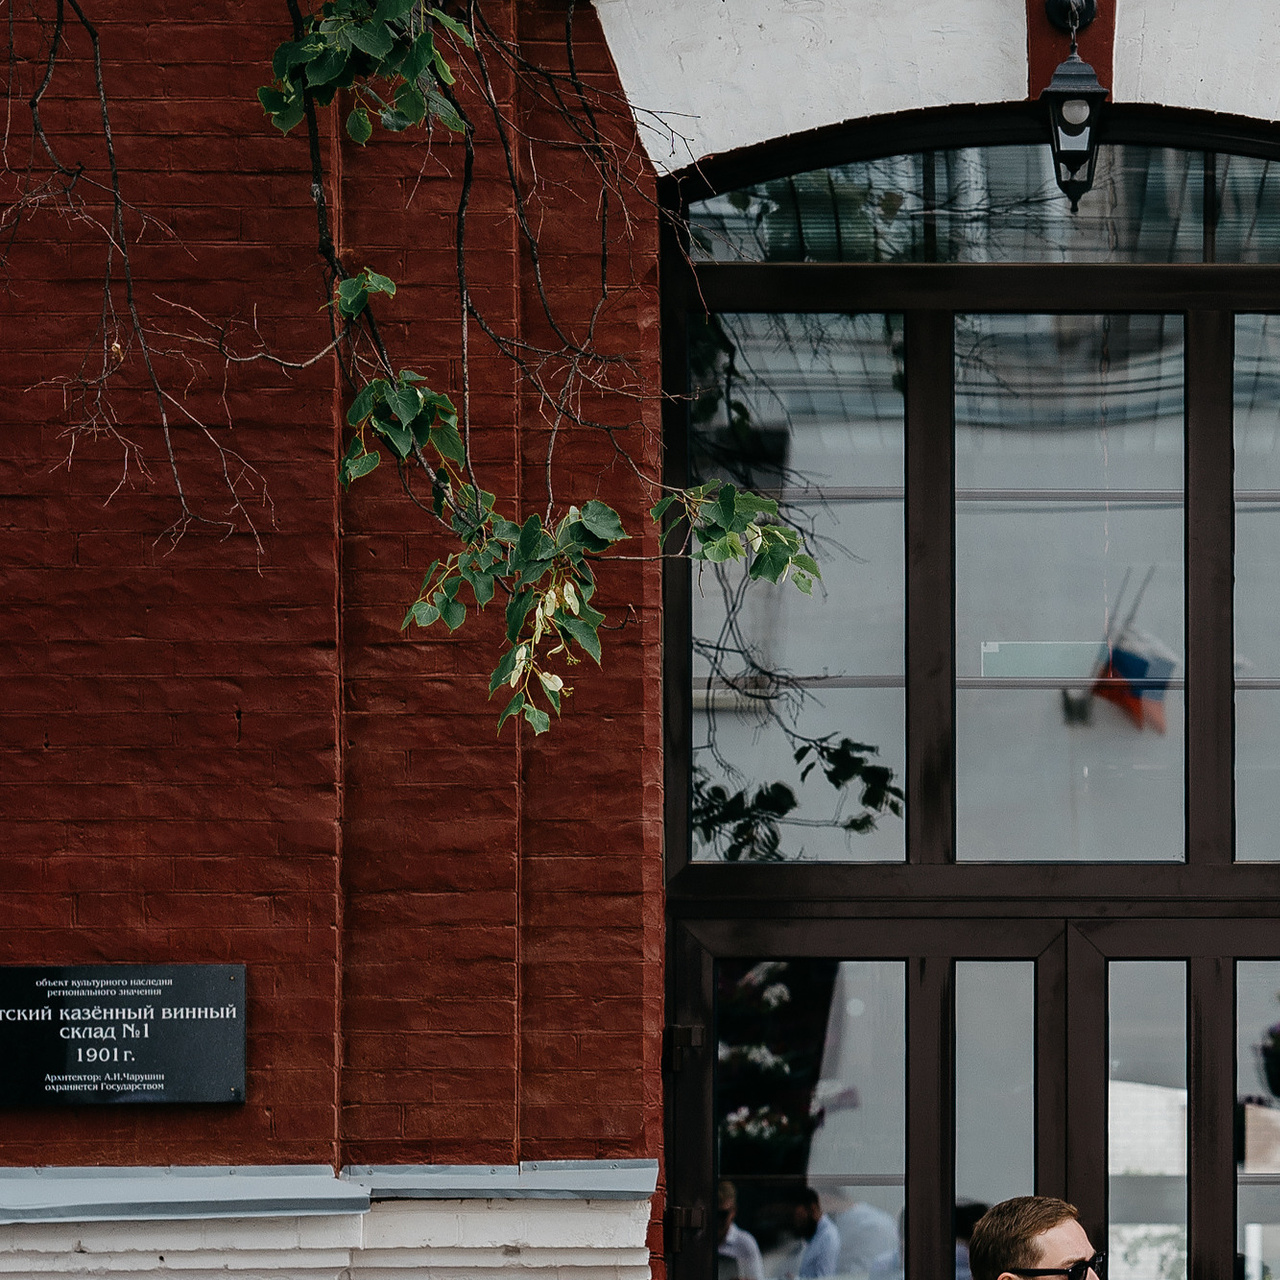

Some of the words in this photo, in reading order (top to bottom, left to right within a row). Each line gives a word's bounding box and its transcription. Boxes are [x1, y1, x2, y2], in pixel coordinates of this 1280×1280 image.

[35, 978, 69, 987] объект
[71, 979, 128, 989] культурного
[130, 978, 173, 987] наследия
[47, 988, 117, 998] регионального
[118, 988, 162, 997] значения
[59, 1005, 155, 1021] казённый
[161, 1003, 237, 1020] винный
[59, 1026, 117, 1041] склад
[44, 1073, 102, 1083] Архитектор:
[44, 1084, 98, 1093] охраняется
[100, 1083, 165, 1093] Государством
